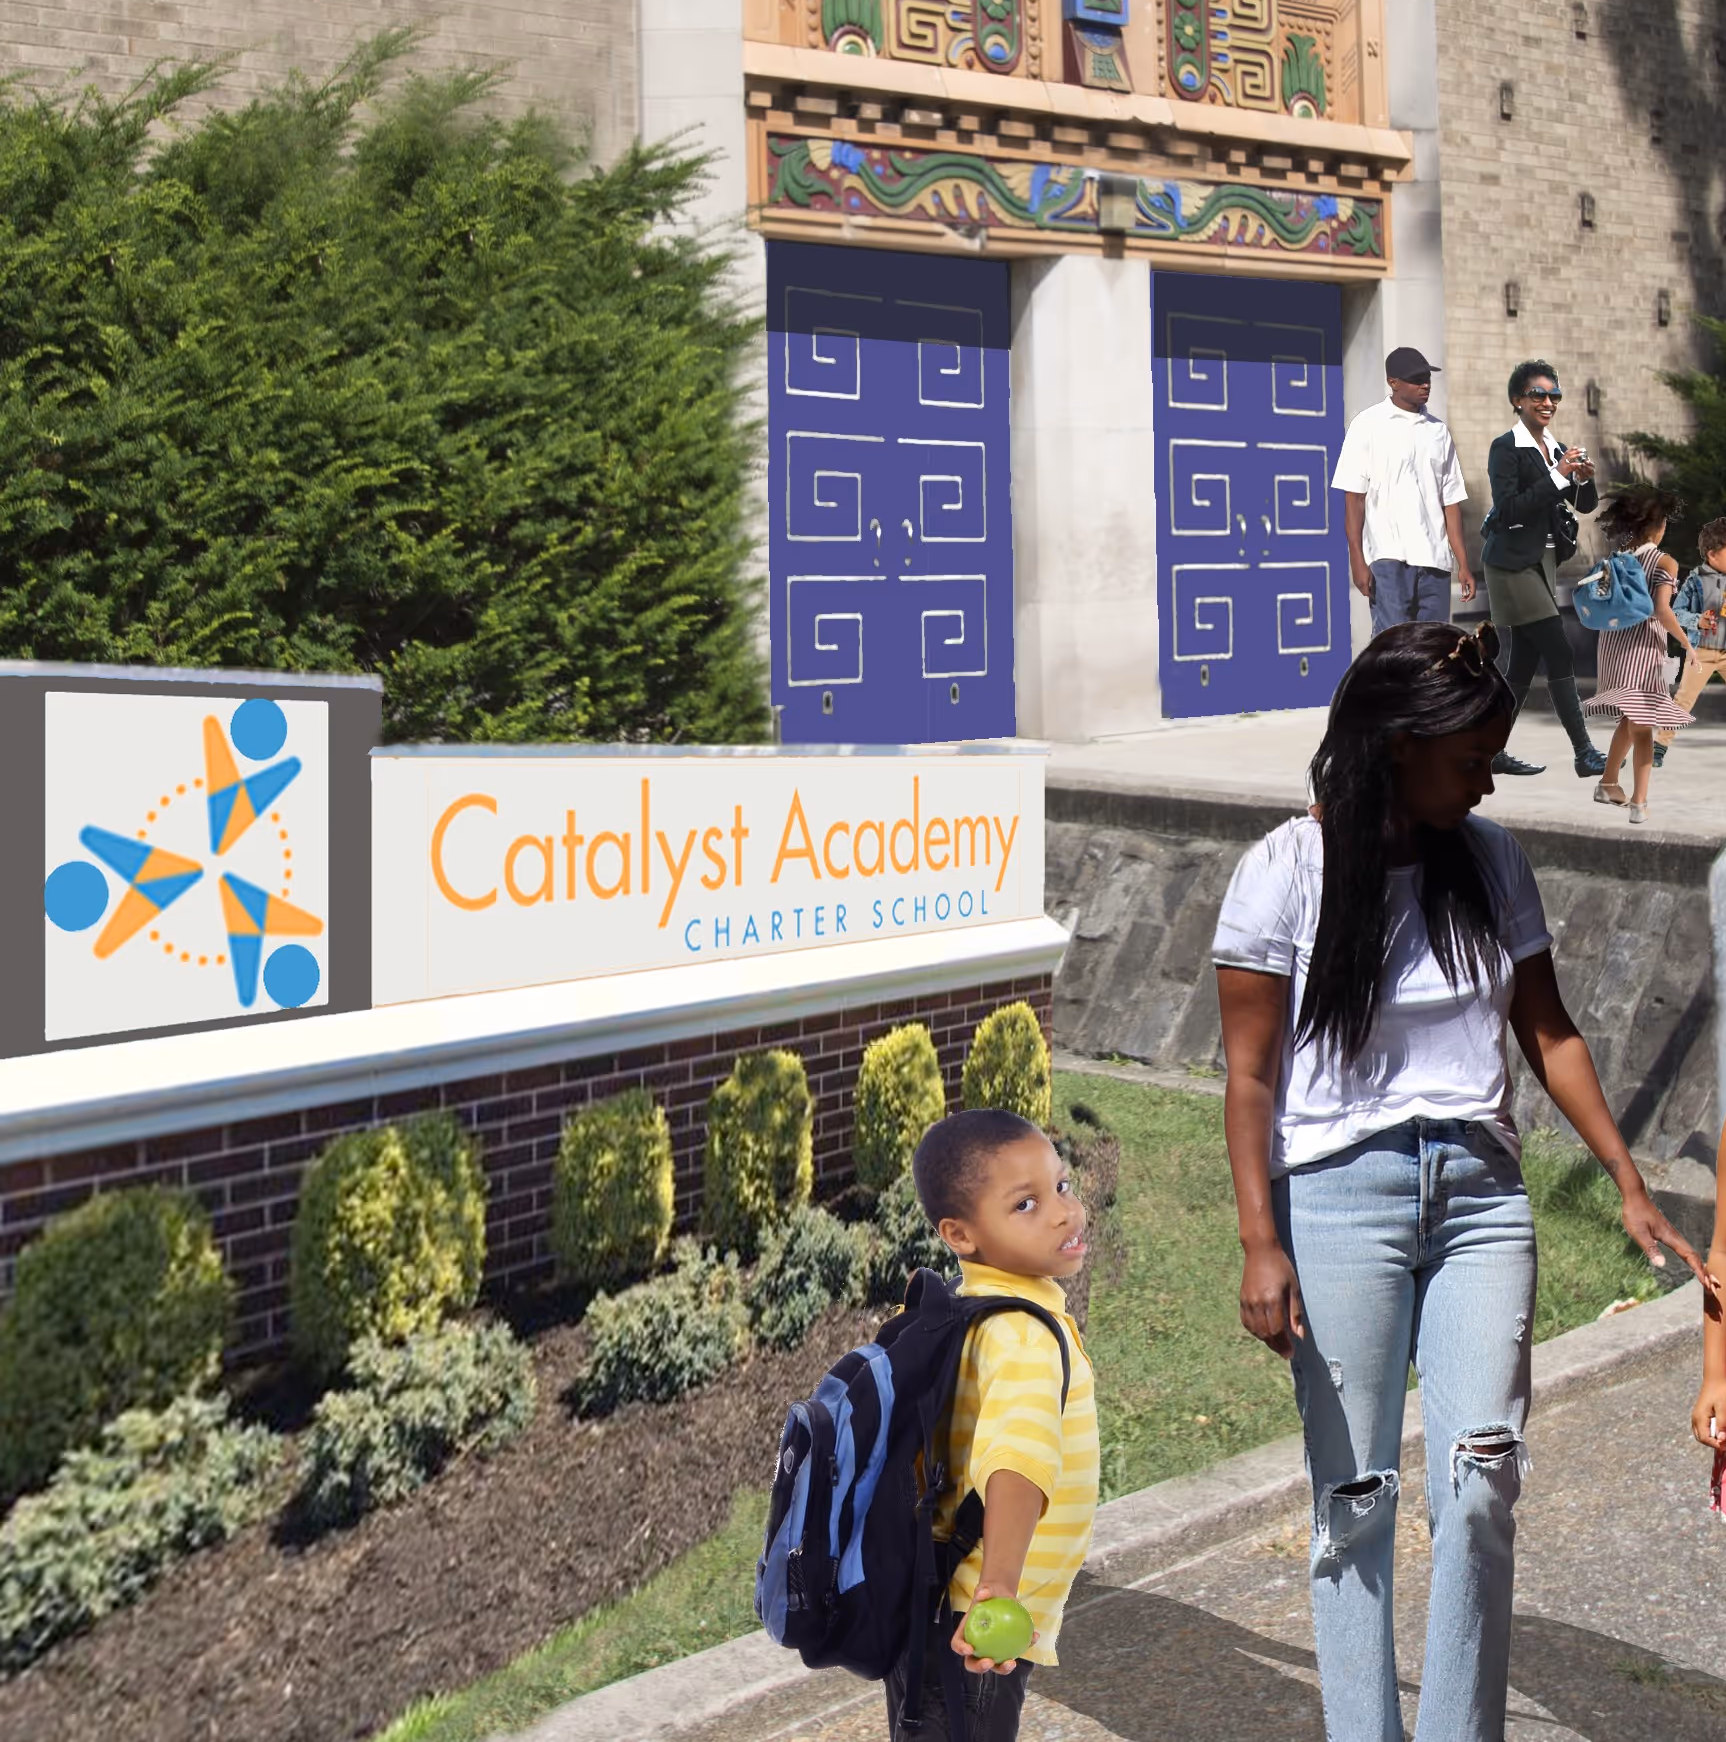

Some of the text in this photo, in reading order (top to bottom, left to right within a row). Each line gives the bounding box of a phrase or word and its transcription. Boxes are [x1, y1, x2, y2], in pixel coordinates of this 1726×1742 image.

[430, 775, 1020, 929] Catalyst Academy
[684, 889, 988, 952] CHARTER SCHOOL
